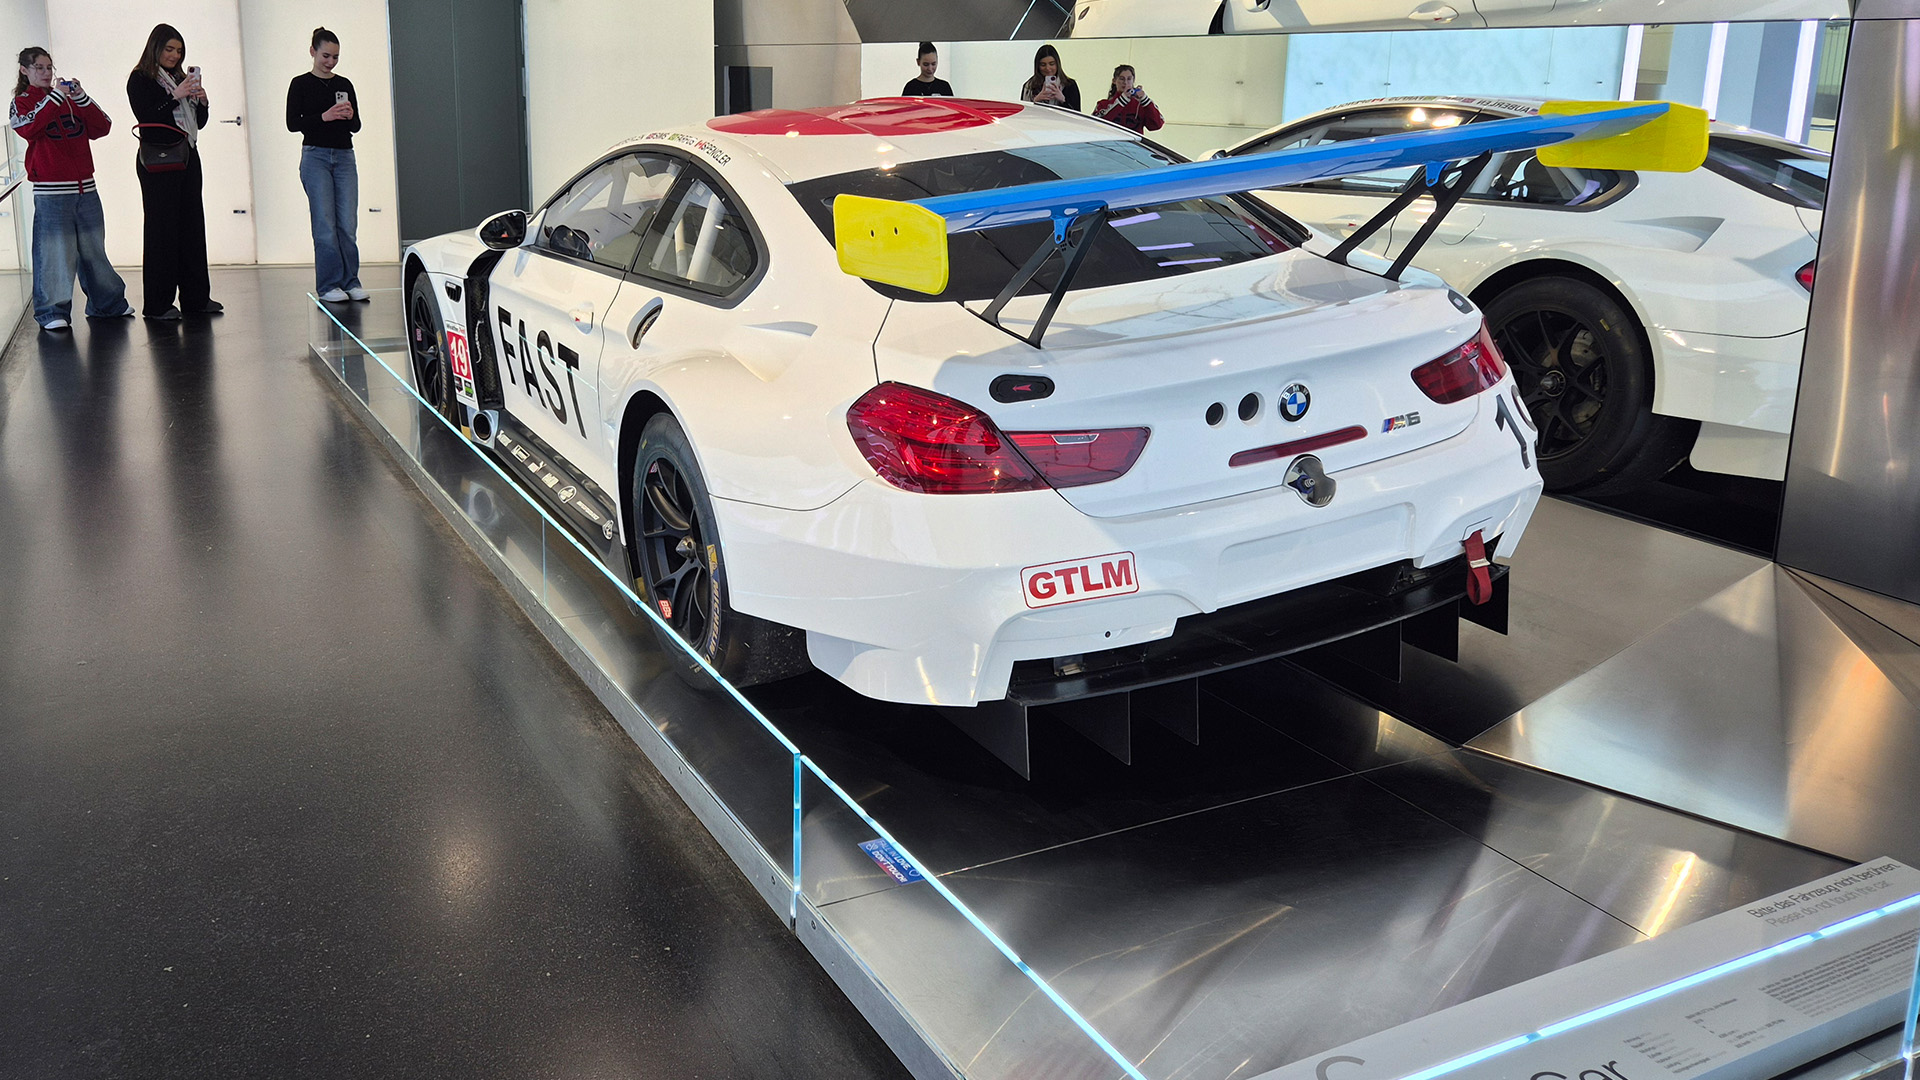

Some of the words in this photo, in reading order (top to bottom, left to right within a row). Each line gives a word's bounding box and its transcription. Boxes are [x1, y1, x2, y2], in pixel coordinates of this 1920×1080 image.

[700, 142, 732, 167] SPENGLER
[450, 336, 468, 377] 19
[497, 305, 588, 440] FAST
[1028, 559, 1133, 600] GTLM
[660, 600, 672, 618] BBS
[709, 580, 720, 655] MICHELIN
[893, 855, 911, 870] LOVE
[1747, 904, 1777, 919] Bitte
[1774, 898, 1795, 911] das
[1788, 882, 1839, 906] Fahrzeug
[1833, 875, 1859, 890] nicht
[1765, 911, 1802, 928] Please
[1800, 904, 1816, 916] do
[1814, 899, 1833, 911] not
